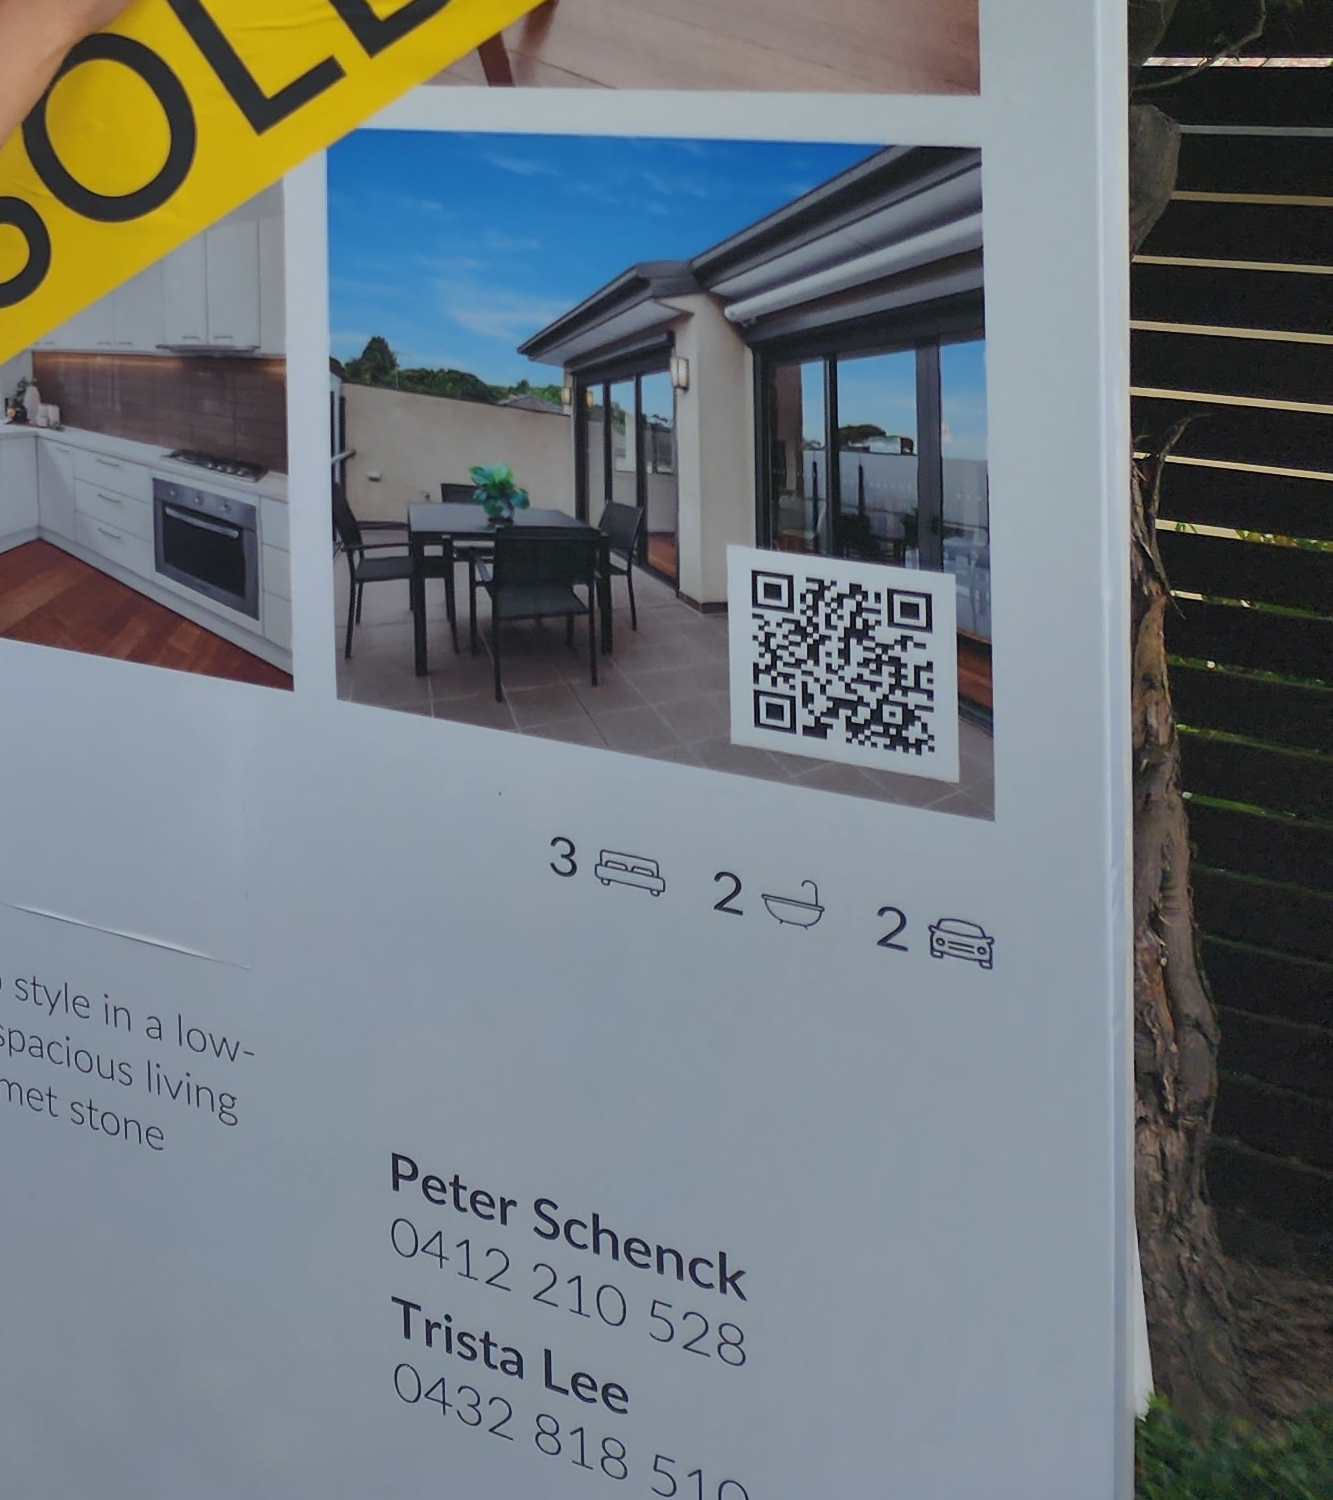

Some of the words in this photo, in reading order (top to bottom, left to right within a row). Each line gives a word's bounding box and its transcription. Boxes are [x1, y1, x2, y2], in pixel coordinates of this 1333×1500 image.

[549, 835, 578, 878] 3
[712, 870, 744, 917] 2
[876, 905, 909, 953] 2
[14, 974, 91, 1021] style
[103, 993, 132, 1034] in
[145, 1015, 163, 1042] a
[177, 1013, 256, 1063] low-
[69, 1097, 165, 1153] stone
[146, 1059, 239, 1127] living
[390, 1151, 518, 1227] Peter
[532, 1197, 748, 1302] Schenck
[390, 1217, 512, 1293] 0412
[532, 1262, 627, 1327] 210
[648, 1298, 747, 1367] 528
[390, 1295, 524, 1381] Trista
[543, 1347, 629, 1415] Lee
[393, 1363, 514, 1442] 0432
[534, 1412, 629, 1481] 818
